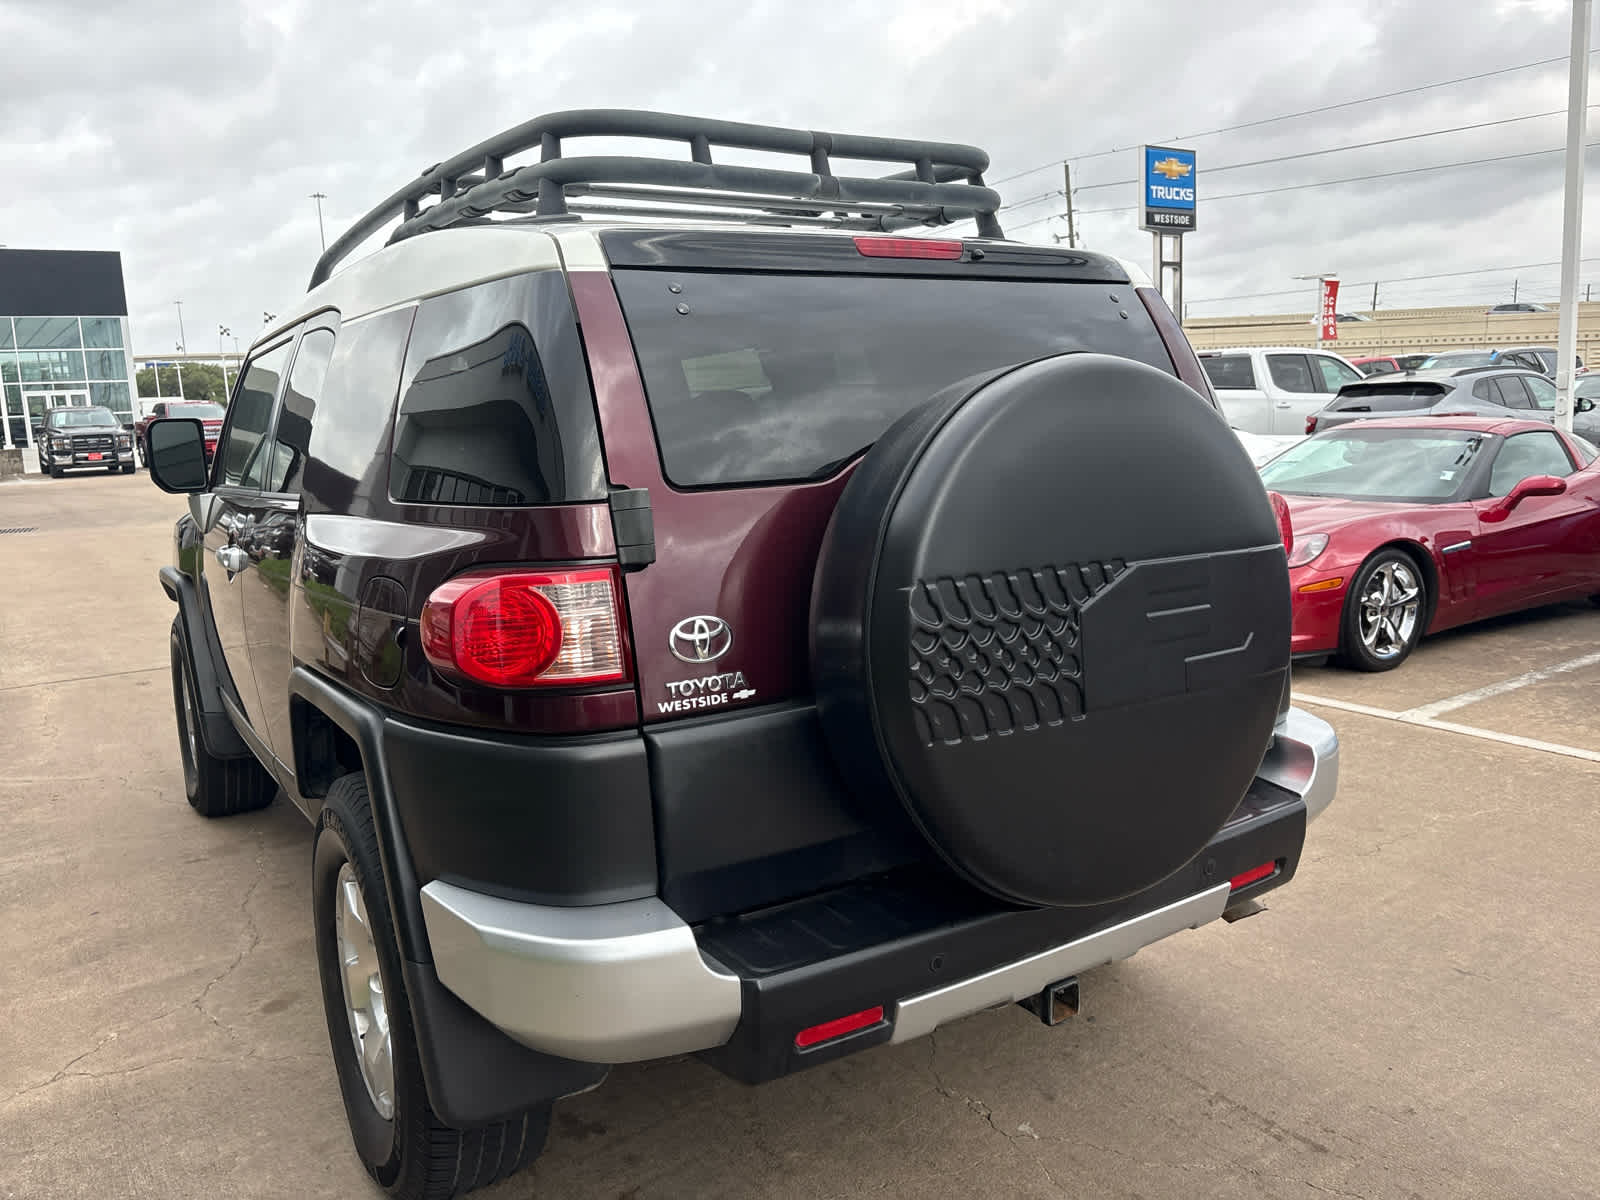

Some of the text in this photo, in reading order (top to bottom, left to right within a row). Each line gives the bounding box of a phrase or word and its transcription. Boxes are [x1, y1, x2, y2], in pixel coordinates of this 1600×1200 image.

[1150, 185, 1194, 201] TRUCKS
[1153, 214, 1190, 224] WESTSIDE
[665, 671, 746, 698] TOYOTA
[657, 693, 729, 713] WESTSIDE
